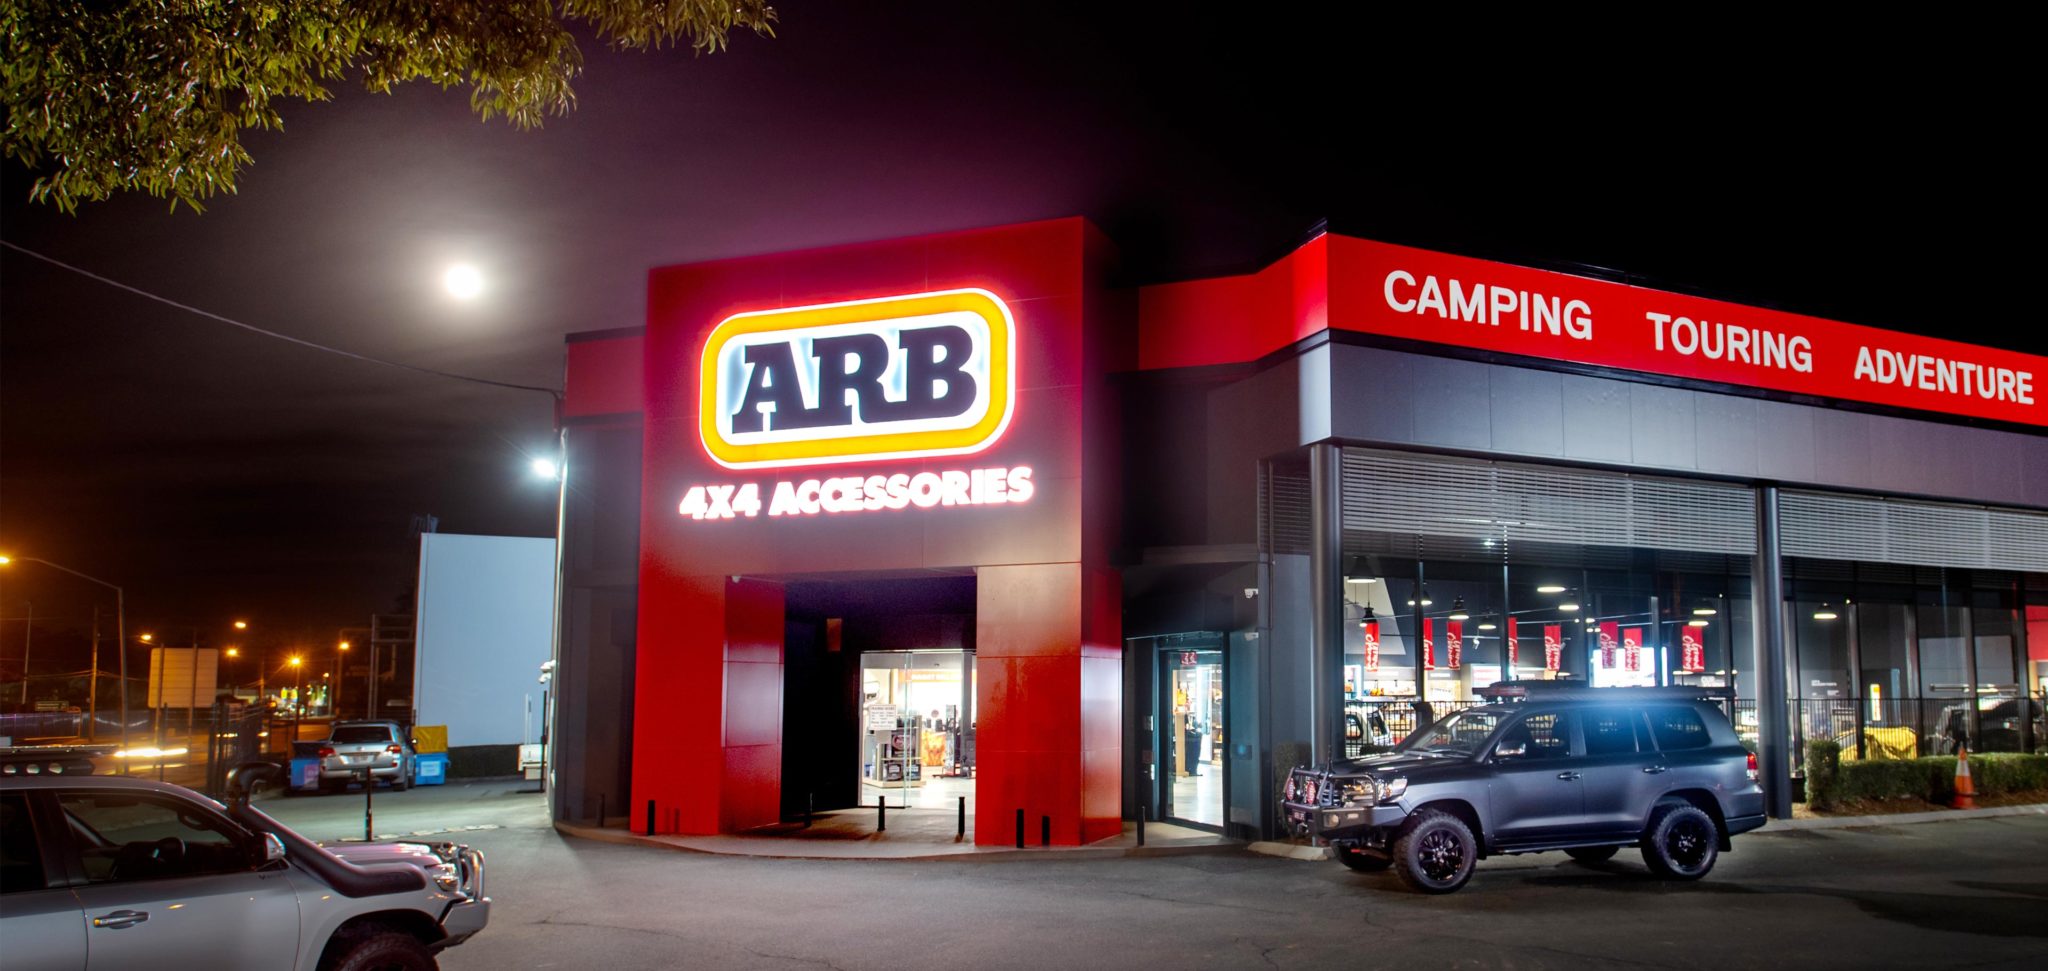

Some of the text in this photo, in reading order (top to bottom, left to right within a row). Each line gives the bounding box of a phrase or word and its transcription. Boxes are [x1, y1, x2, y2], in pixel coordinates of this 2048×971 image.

[731, 325, 977, 434] ARB
[1384, 270, 2034, 405] CAMPING TOURING ADVENTURE
[679, 466, 1034, 520] 4X4 ACCESSORIES
